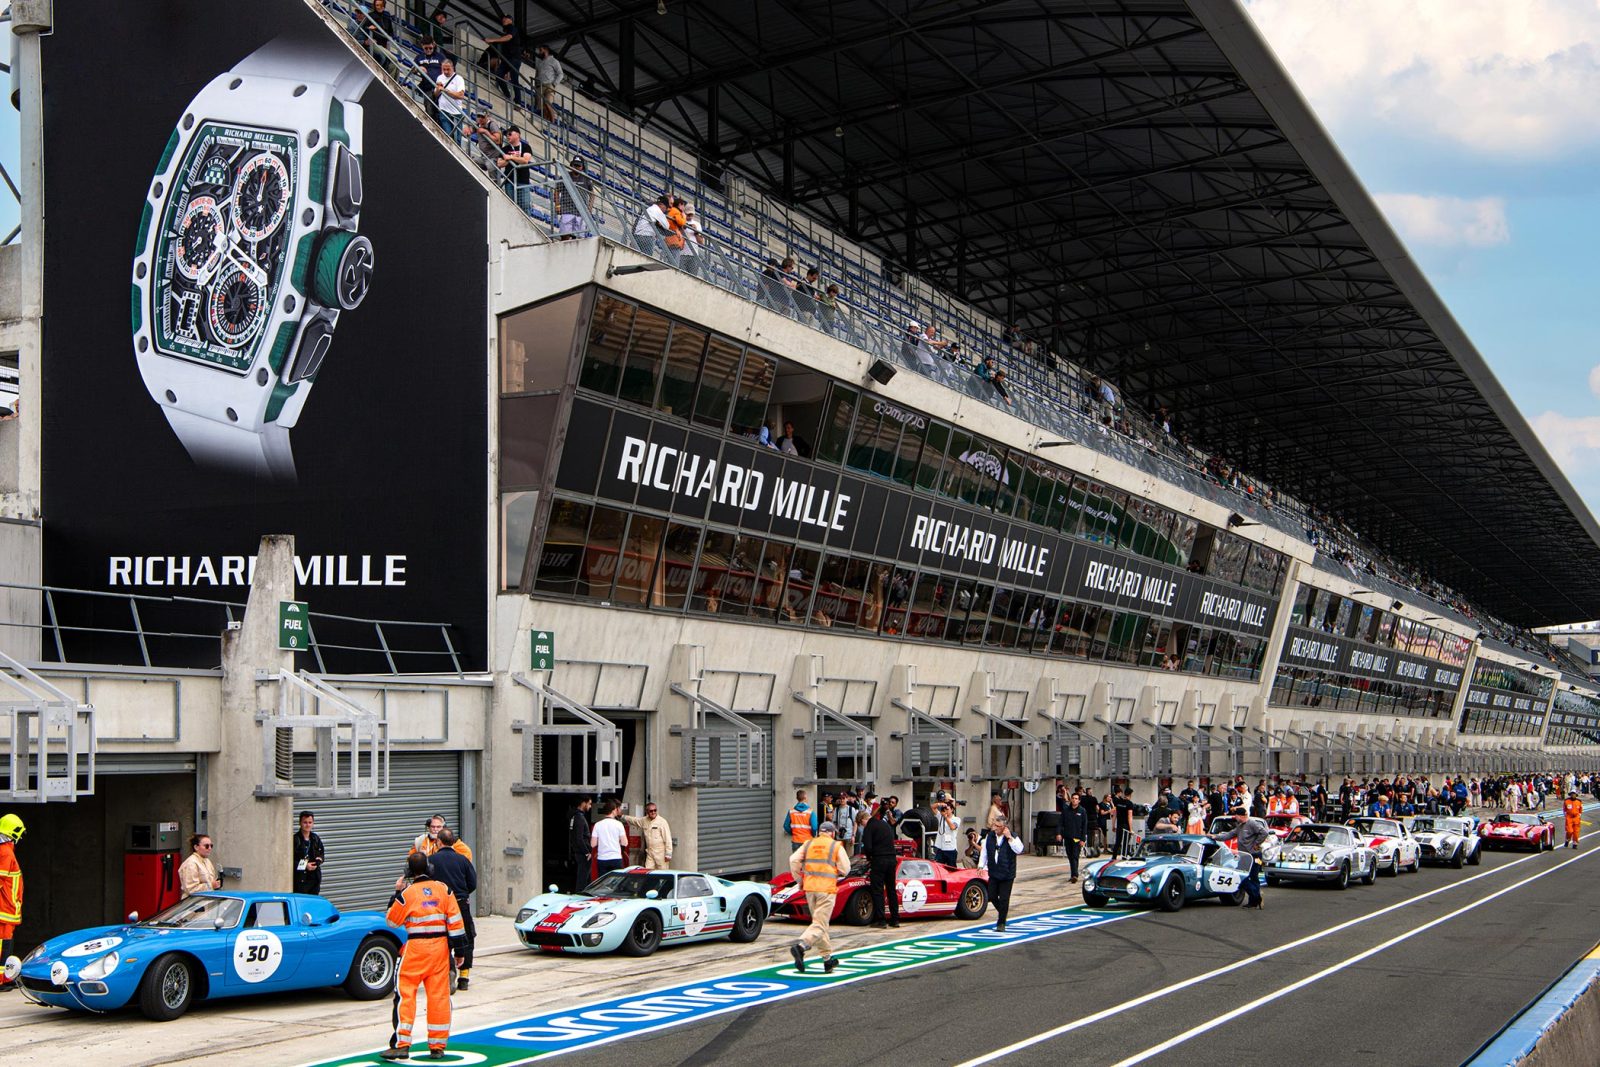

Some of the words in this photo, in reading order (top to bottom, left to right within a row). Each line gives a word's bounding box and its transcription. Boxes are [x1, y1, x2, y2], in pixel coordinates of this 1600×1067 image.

[224, 128, 253, 139] RICHARD
[254, 133, 274, 142] MILLE
[617, 435, 764, 511] RICHARD
[769, 476, 851, 532] MILLE
[910, 514, 996, 565] RICHARD
[997, 536, 1049, 577] MILLE
[109, 556, 258, 586] RICHAR
[293, 555, 407, 586] MILLE
[1084, 560, 1142, 598] RICHARD
[1141, 575, 1177, 607] MILLE
[1200, 591, 1241, 620] RICHARD
[1240, 600, 1267, 628] MILLE
[284, 619, 303, 630] FUEL
[535, 645, 550, 654] FUEL
[1290, 637, 1320, 660] RICHARD
[1318, 642, 1339, 663] MILLE
[1216, 875, 1233, 886] 54
[911, 890, 919, 902] 9
[693, 910, 700, 923] 2
[246, 944, 270, 963] 30
[775, 940, 977, 978] aramco
[495, 981, 790, 1042] aramco
